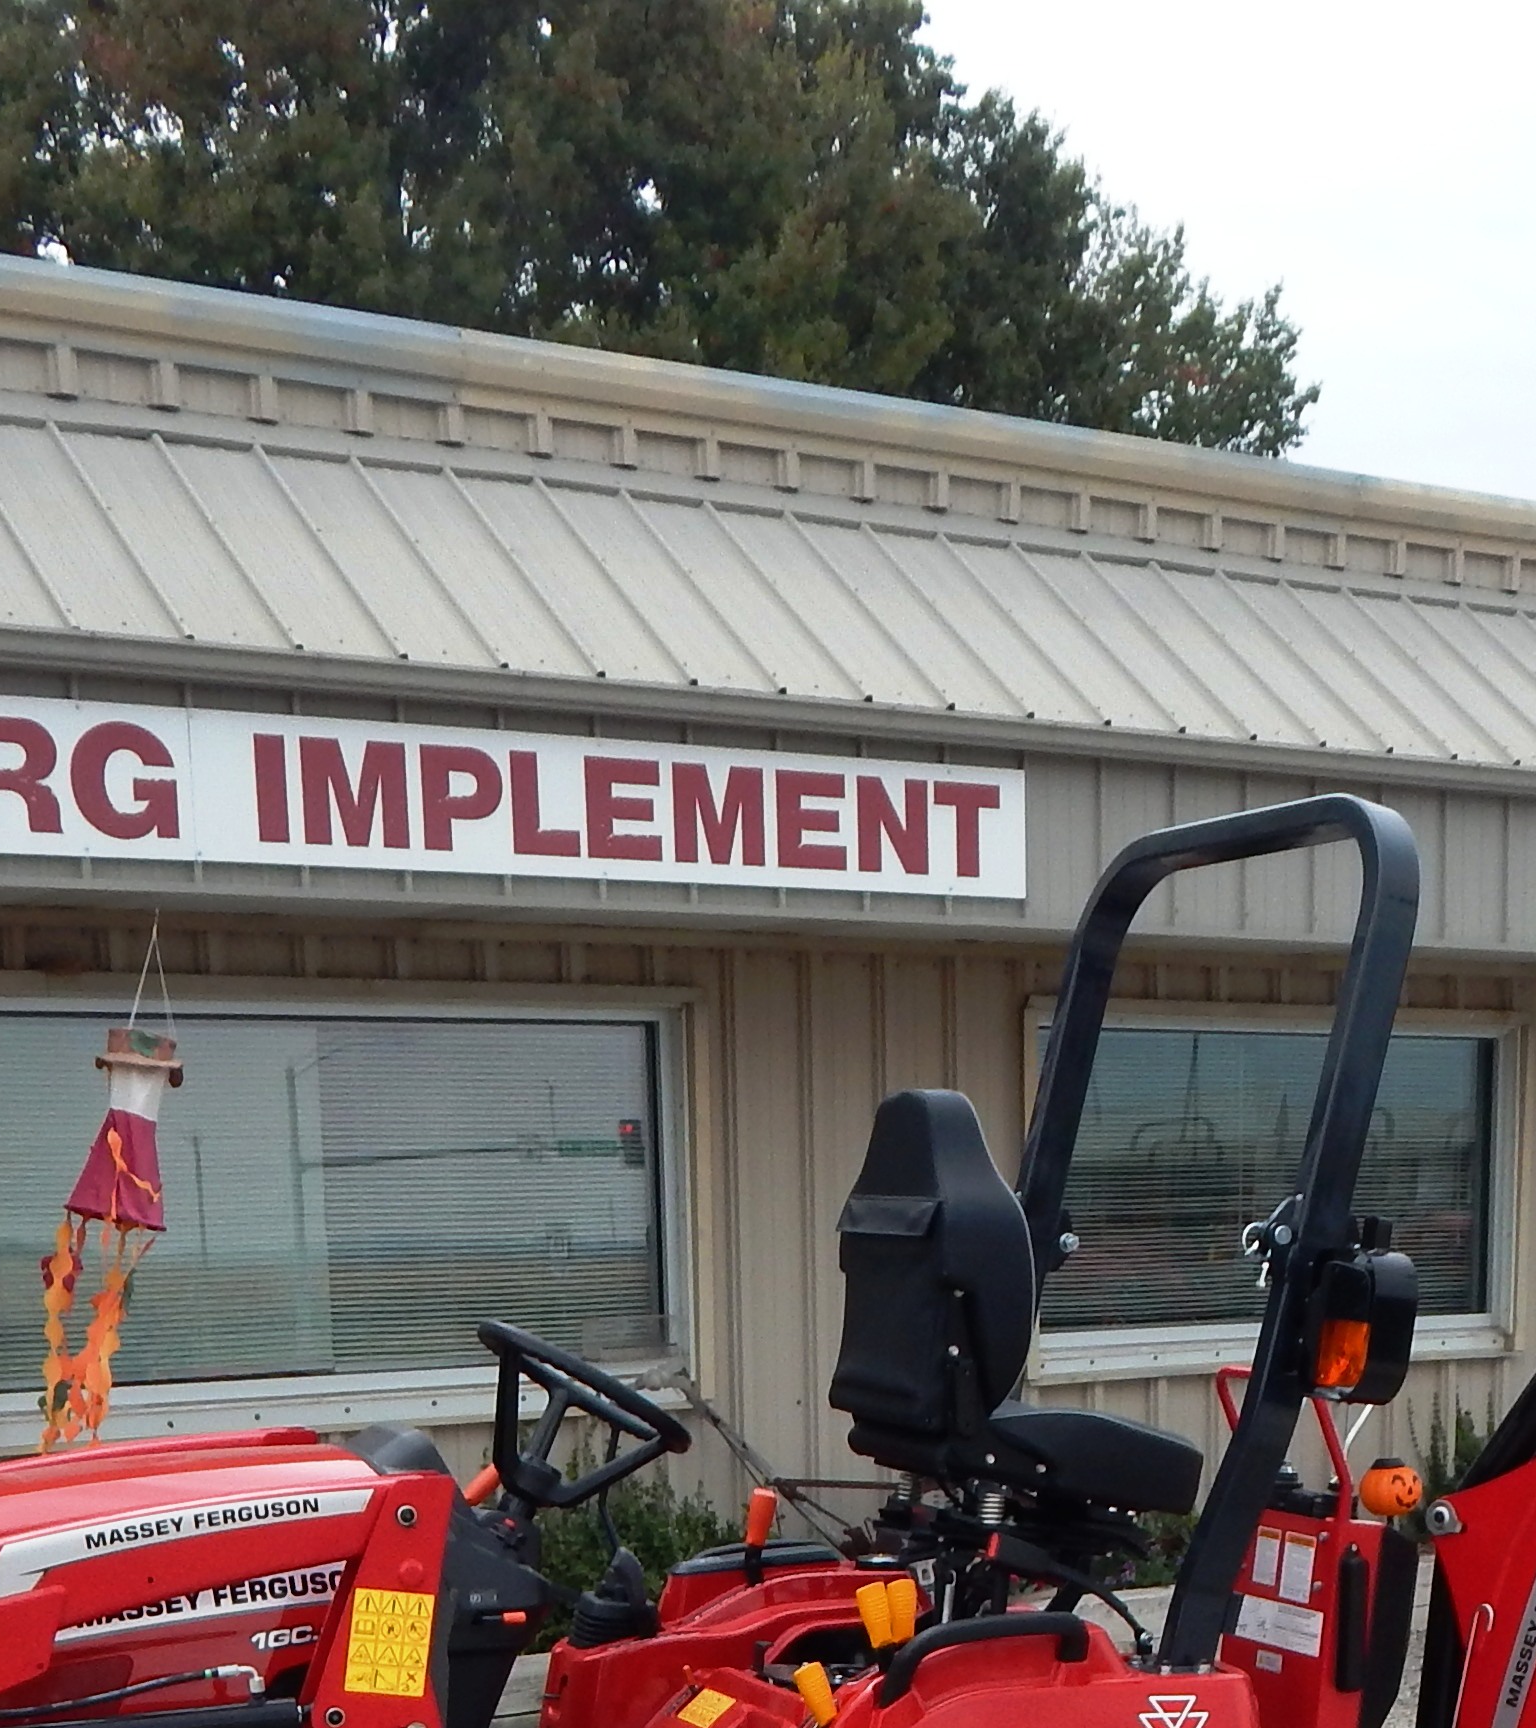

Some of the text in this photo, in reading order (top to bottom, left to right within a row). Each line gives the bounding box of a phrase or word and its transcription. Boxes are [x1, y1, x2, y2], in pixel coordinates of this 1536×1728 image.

[253, 736, 1000, 878] IMPLEMENT
[85, 1497, 320, 1550] MASSEY FERGUSON
[75, 1570, 344, 1629] SSEY FERGUSO
[251, 1625, 319, 1650] 1GC.
